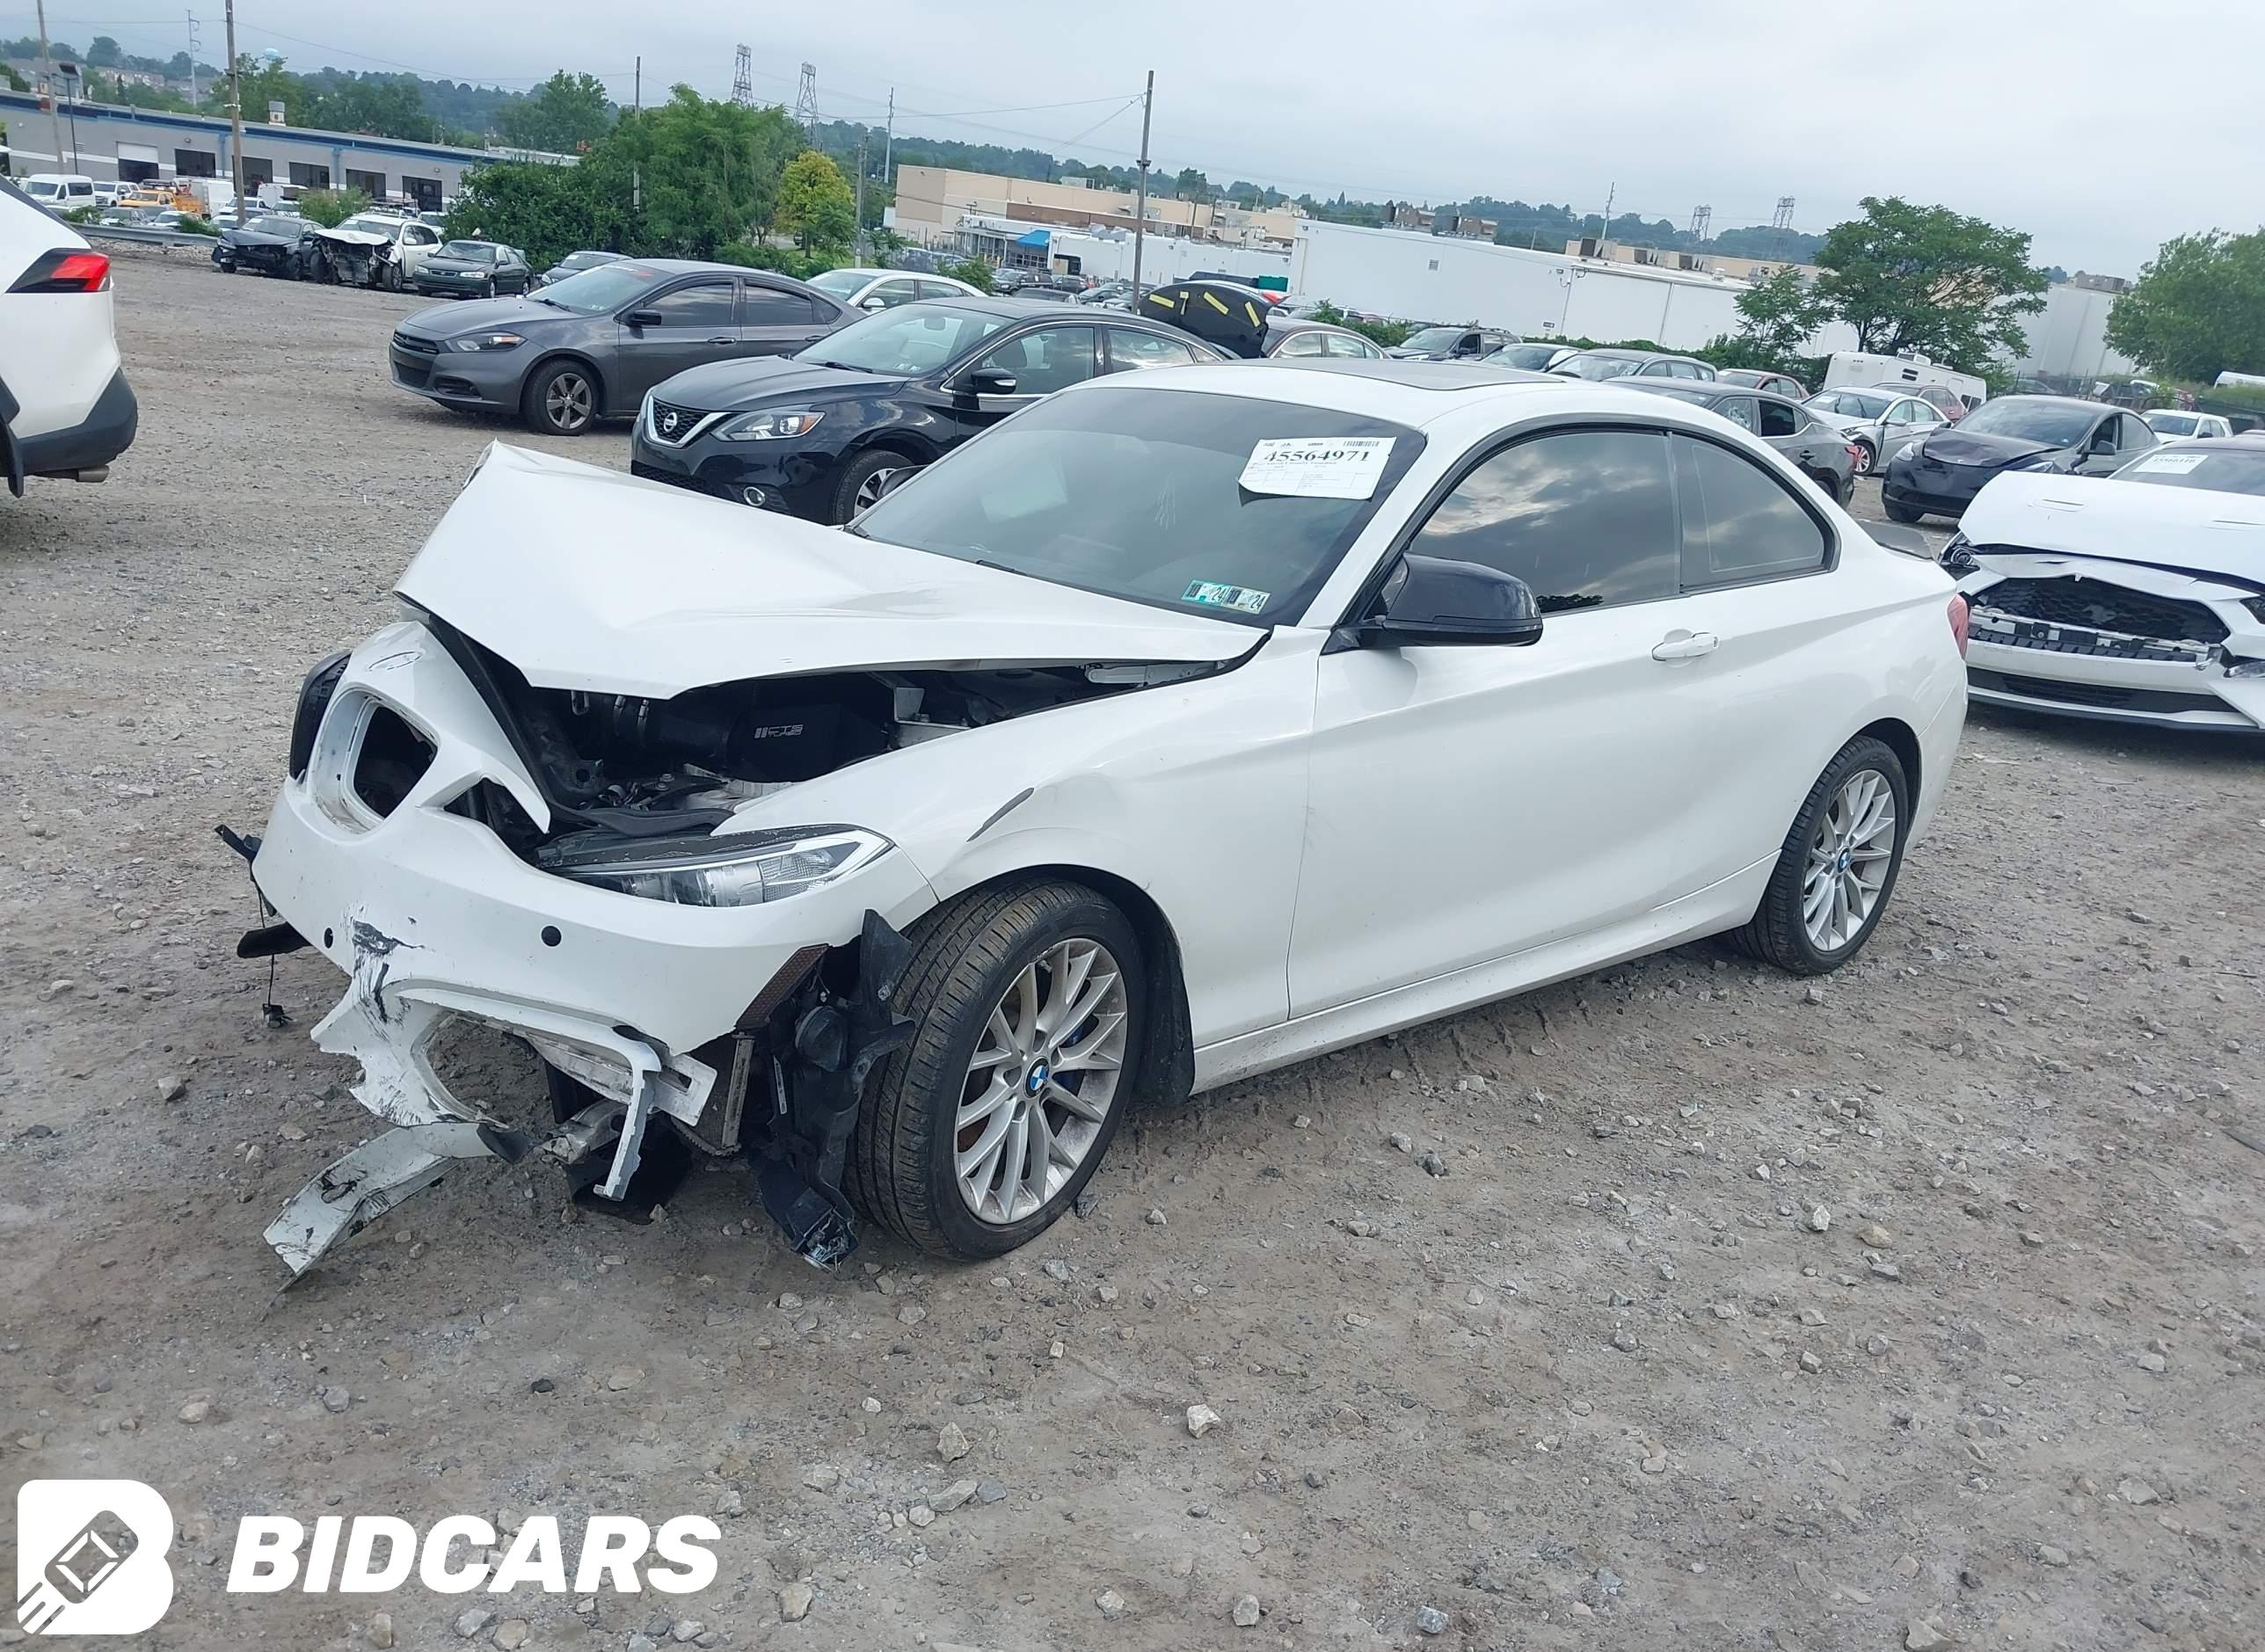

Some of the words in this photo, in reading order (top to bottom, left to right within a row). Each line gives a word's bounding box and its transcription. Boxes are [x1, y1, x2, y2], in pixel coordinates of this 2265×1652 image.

[1264, 449, 1371, 462] 45564971
[1212, 586, 1227, 601] 24
[1250, 594, 1267, 609] 24
